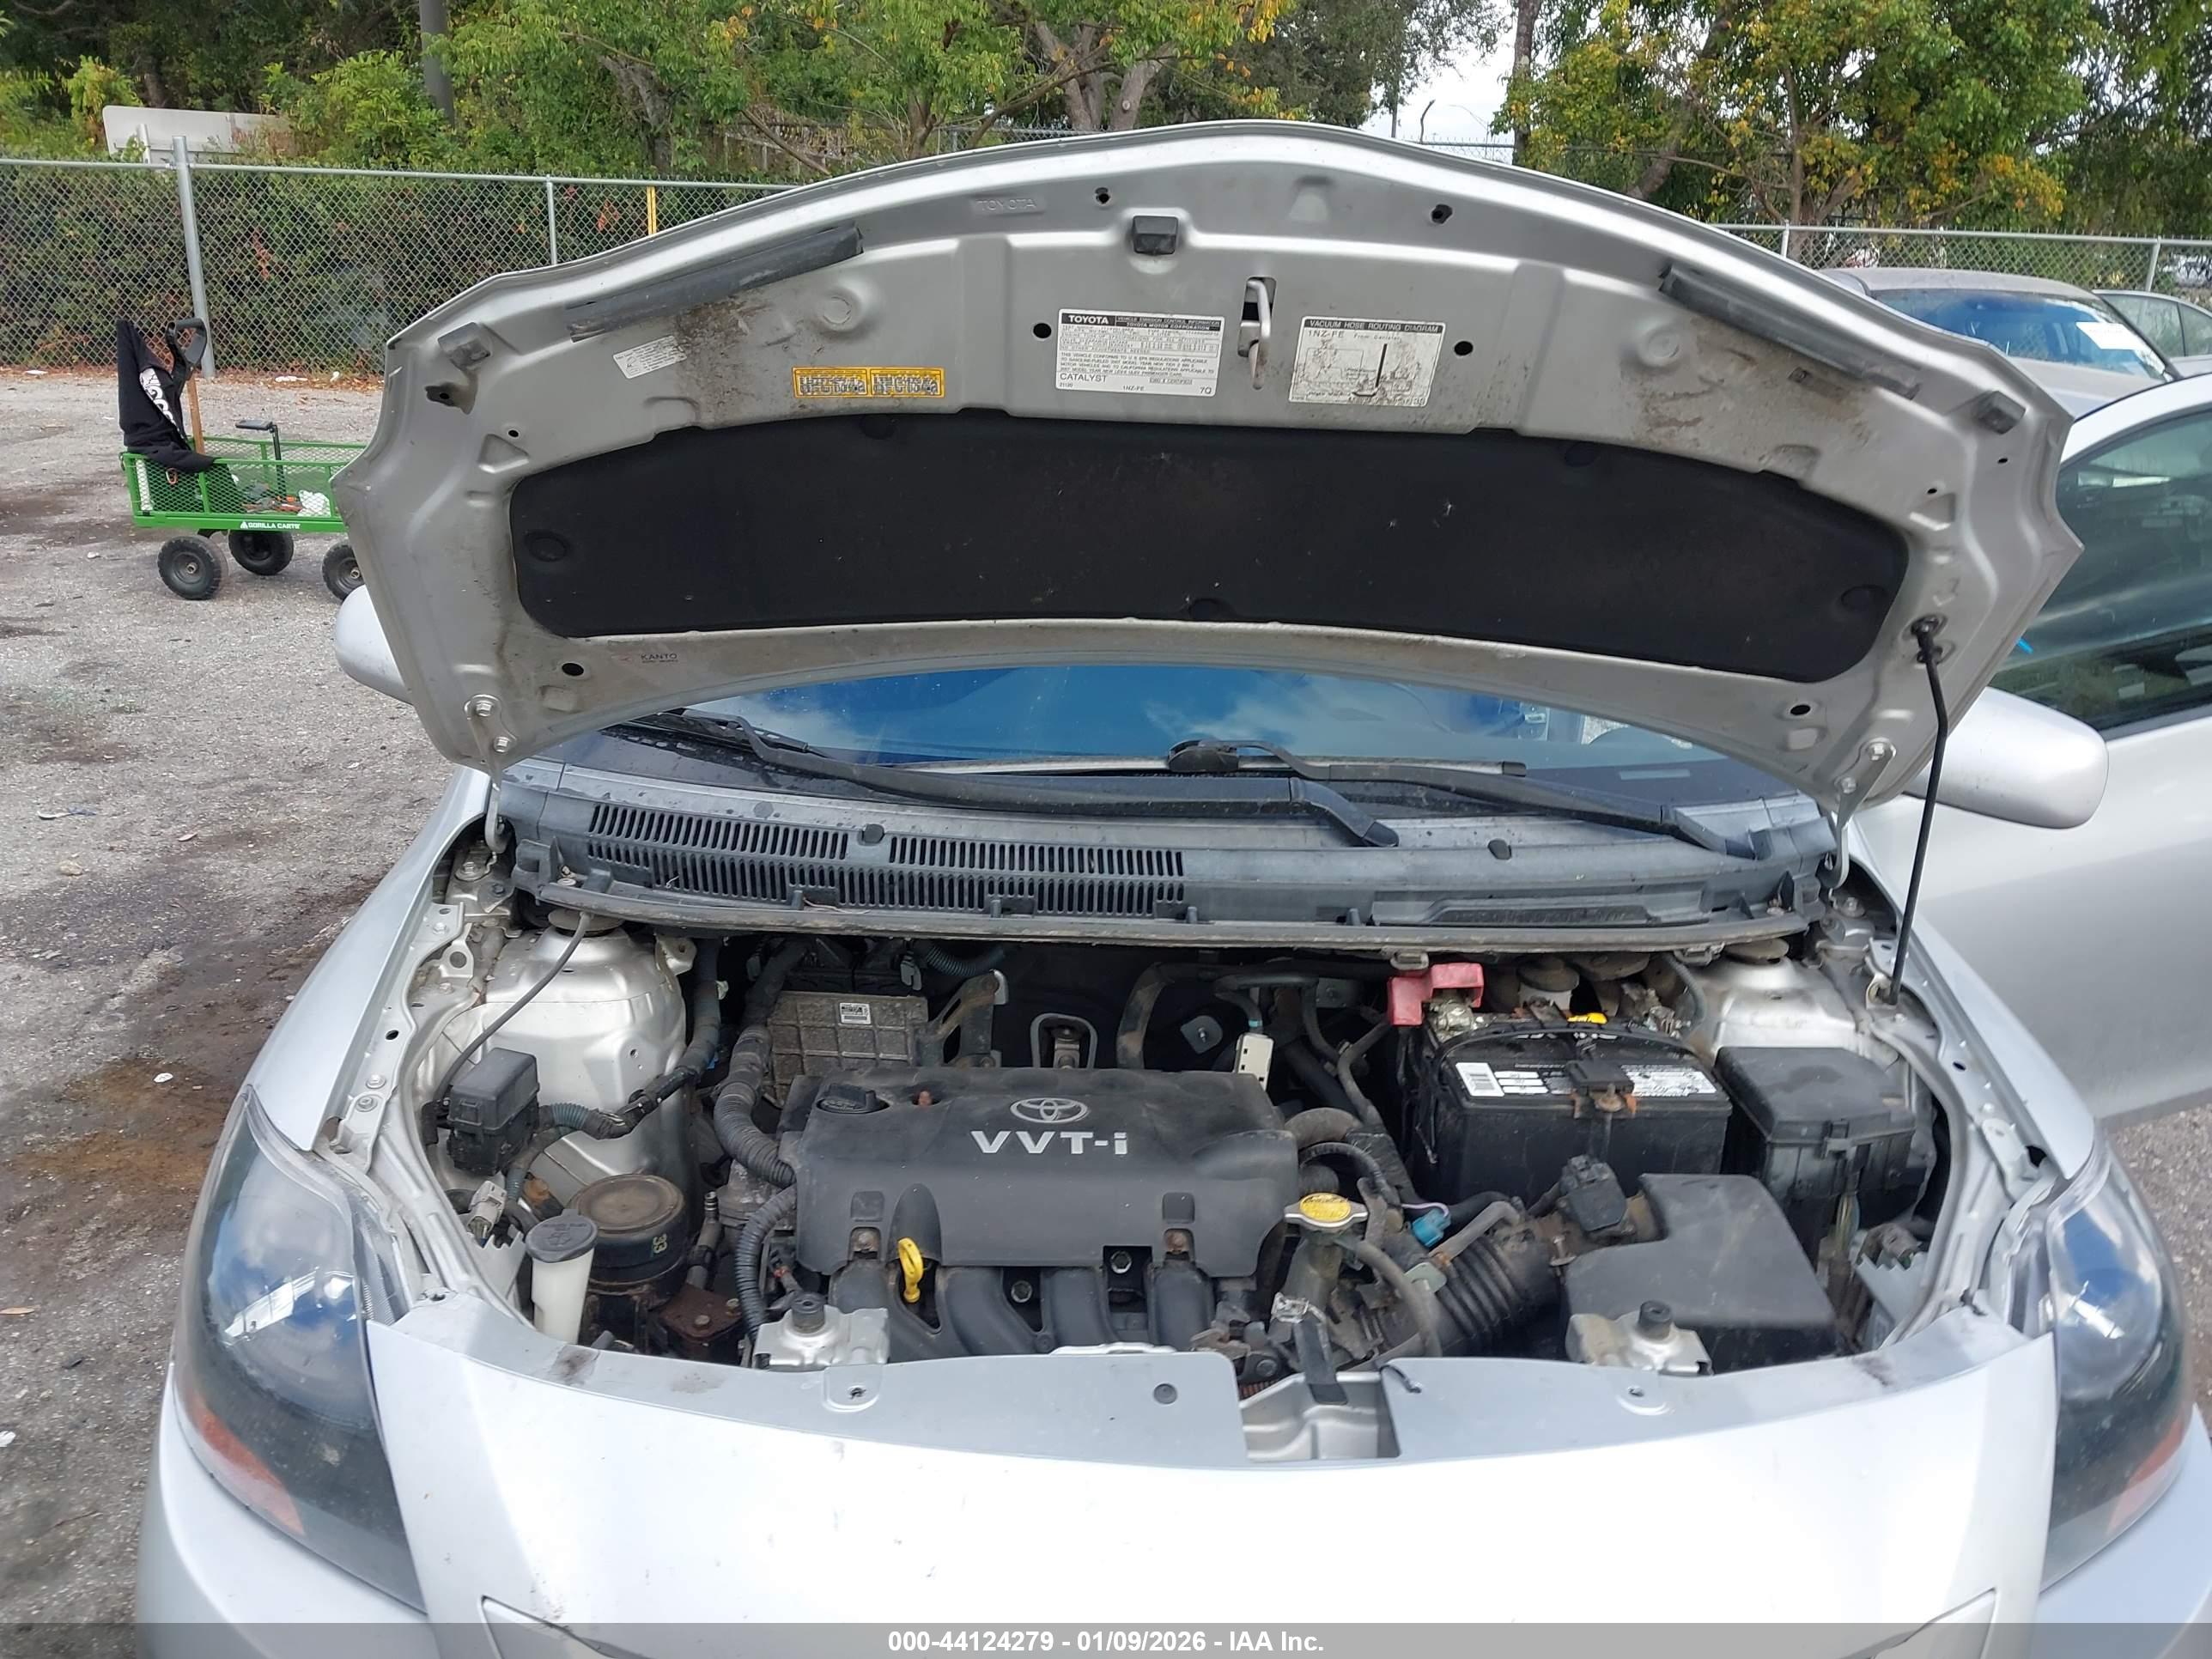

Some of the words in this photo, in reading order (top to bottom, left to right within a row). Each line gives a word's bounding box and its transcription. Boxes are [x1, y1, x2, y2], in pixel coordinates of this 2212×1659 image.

[975, 198, 1036, 211] TOYOTA
[1068, 315, 1109, 325] TOYOTA
[1309, 330, 1345, 338] 1NZ-FE
[1404, 325, 1438, 333] DIAGRAM
[1060, 372, 1107, 383] CATALYST
[970, 1130, 1127, 1155] VVT-i
